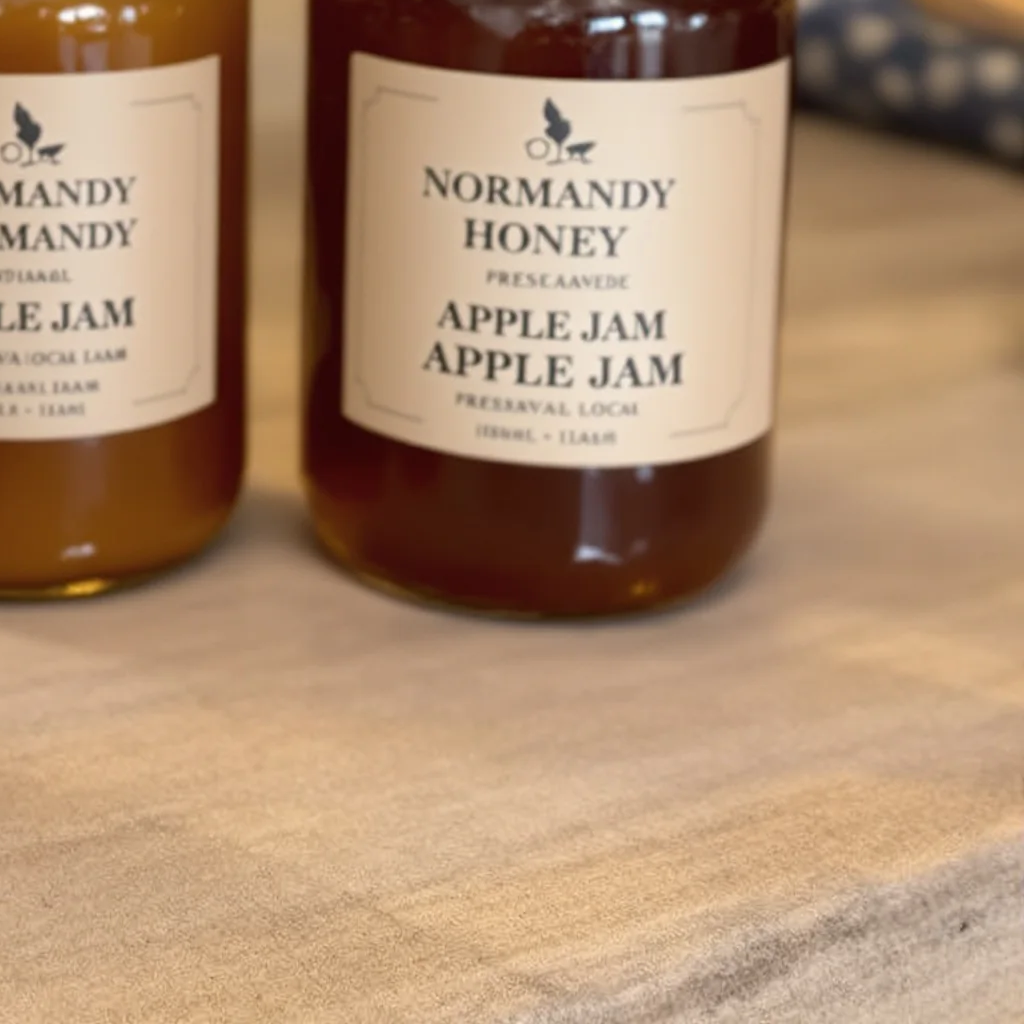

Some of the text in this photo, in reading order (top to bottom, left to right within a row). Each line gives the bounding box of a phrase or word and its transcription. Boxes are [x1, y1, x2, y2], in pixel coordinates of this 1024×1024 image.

[423, 166, 675, 210] NORMANDY
[464, 217, 626, 257] HONEY
[50, 297, 134, 332] JAM
[437, 300, 665, 342] APPLE JAM
[422, 341, 683, 389] APPLE JAM
